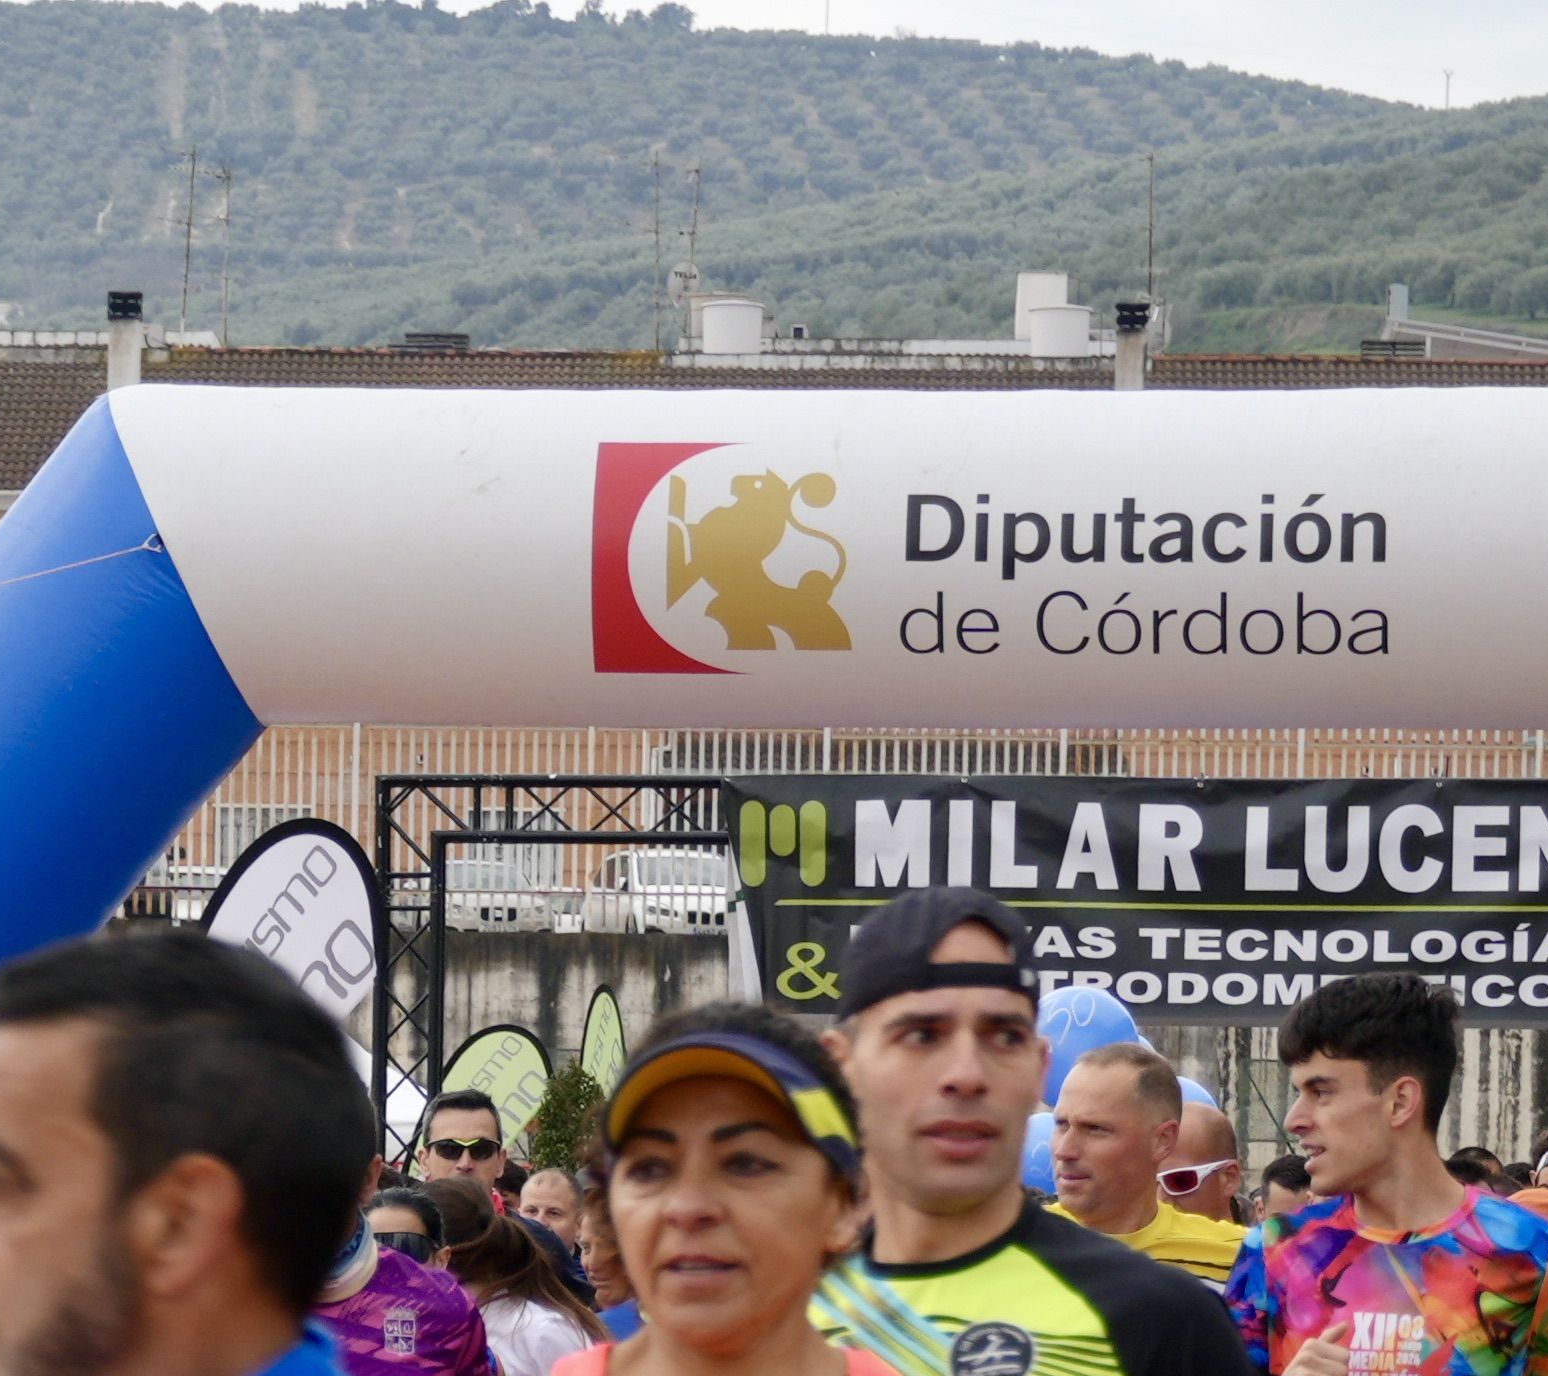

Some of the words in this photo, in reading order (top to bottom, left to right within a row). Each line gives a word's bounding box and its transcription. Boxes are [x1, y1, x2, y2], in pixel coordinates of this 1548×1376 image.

[904, 492, 1390, 579] Diputación
[898, 592, 1002, 656] de
[1036, 586, 1392, 657] Córdoba
[854, 801, 1205, 889] MILAR
[776, 941, 842, 1000] &
[1349, 1311, 1398, 1350] XII
[1398, 1313, 1425, 1340] 08
[1349, 1350, 1395, 1371] MEDIA
